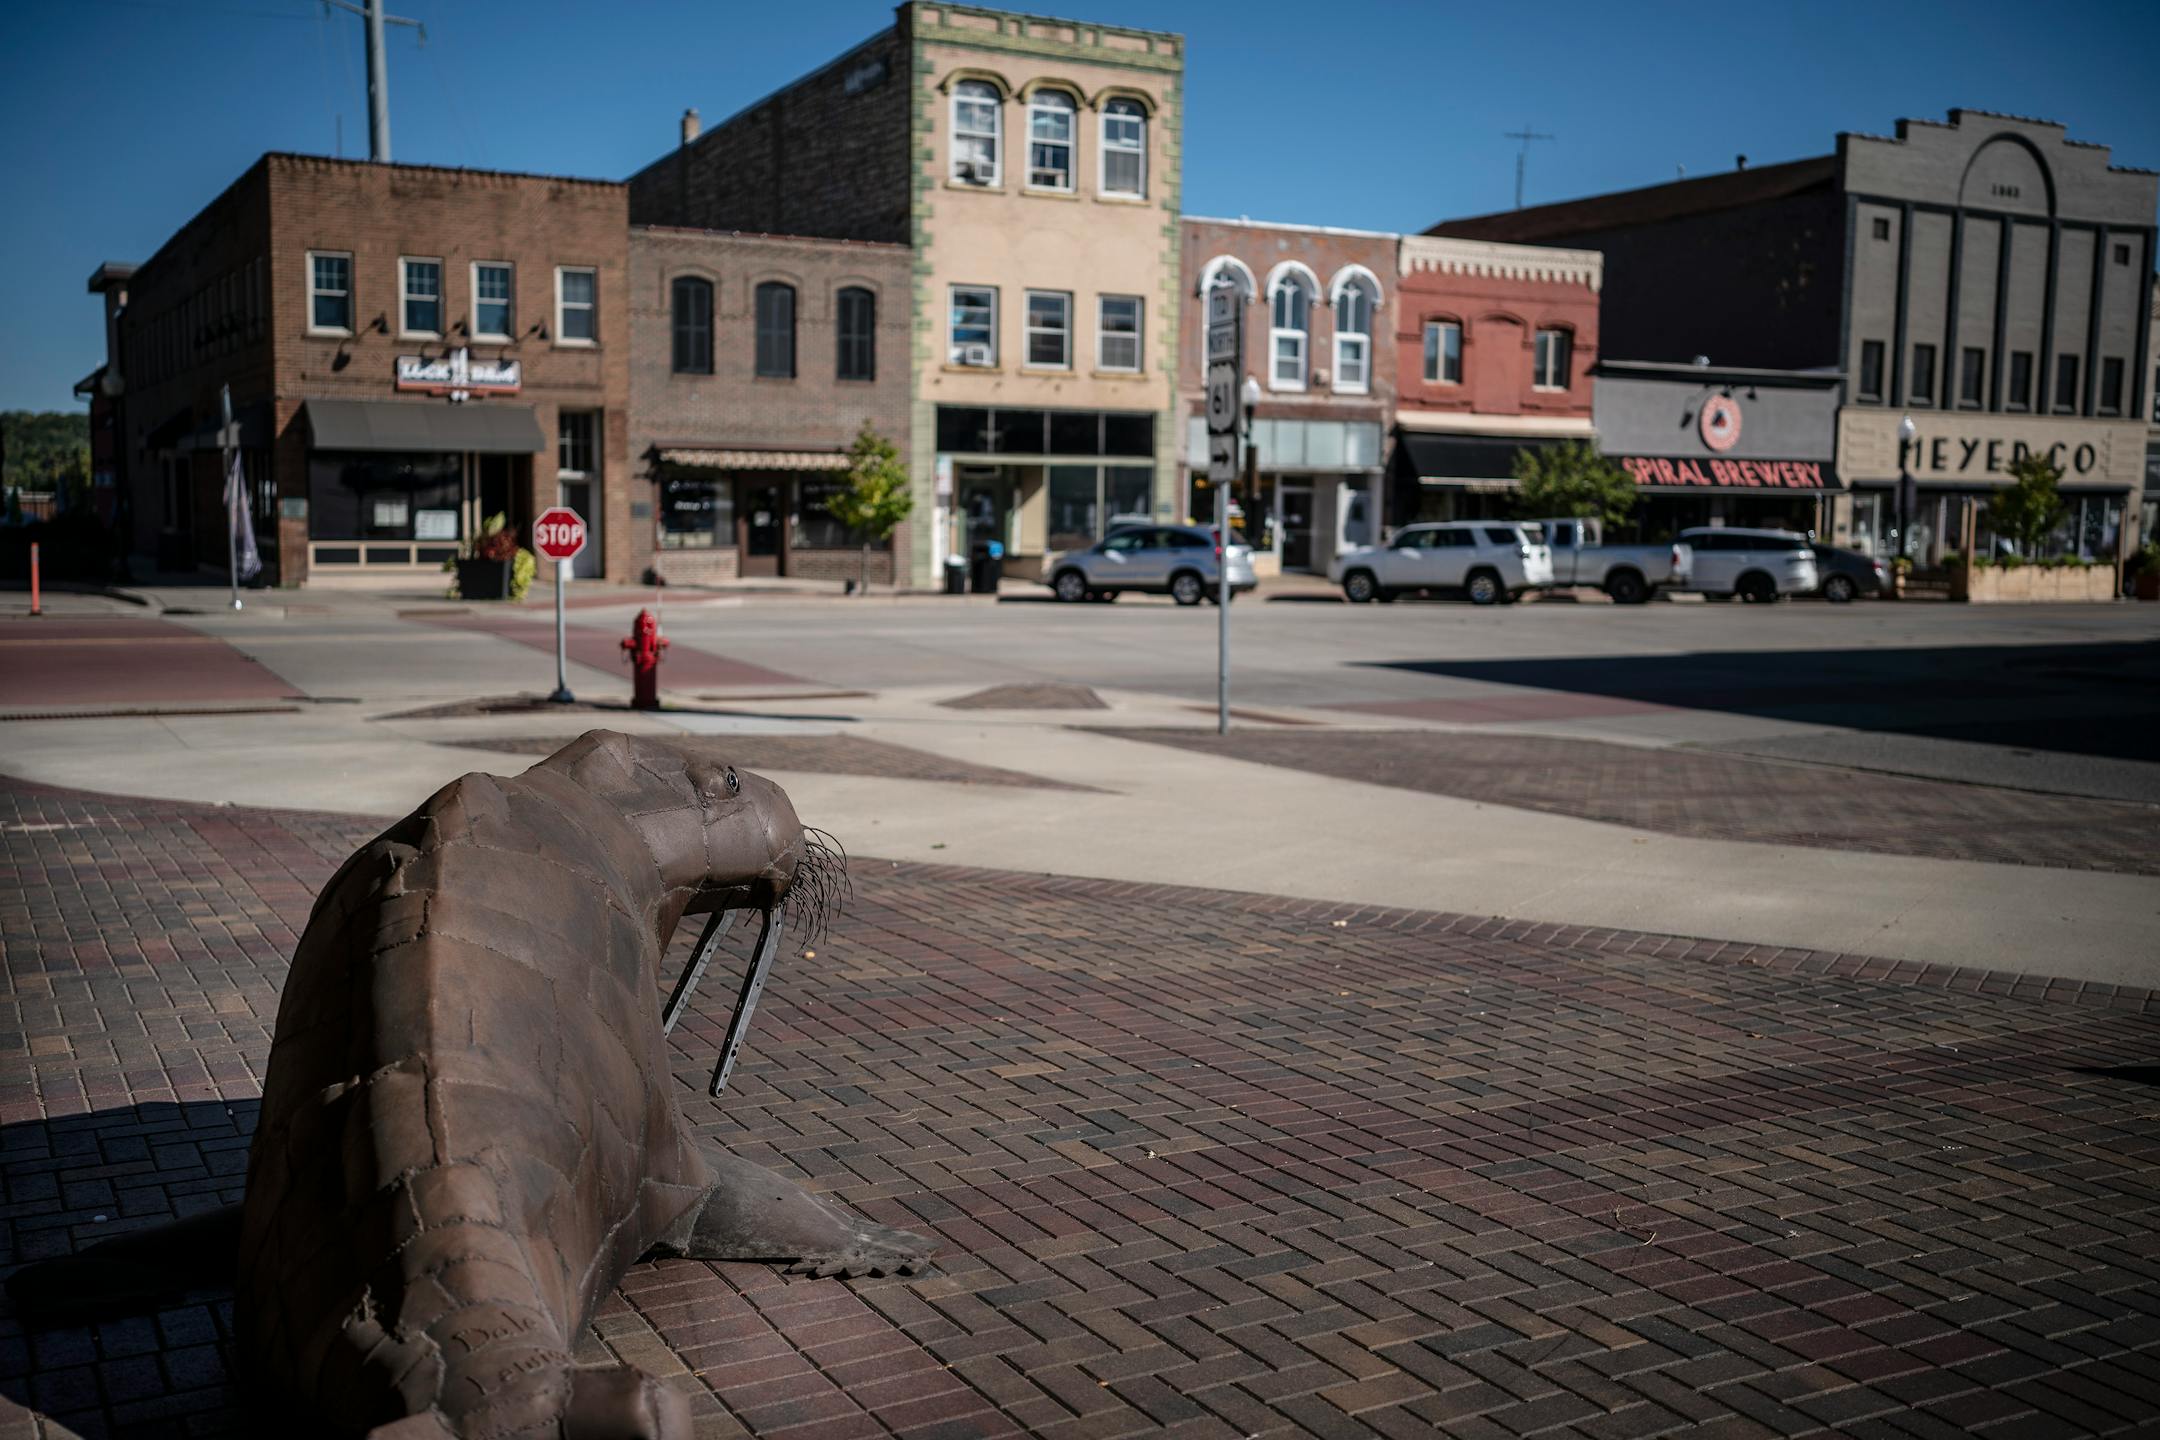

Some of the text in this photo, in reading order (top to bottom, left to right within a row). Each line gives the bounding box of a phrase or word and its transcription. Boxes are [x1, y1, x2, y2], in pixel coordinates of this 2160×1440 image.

[1213, 384, 1229, 414] 61
[1622, 457, 1824, 488] SPIRAL BREWERY
[2048, 441, 2096, 473] CO
[536, 523, 582, 546] STOP
[451, 1312, 536, 1353] Dale
